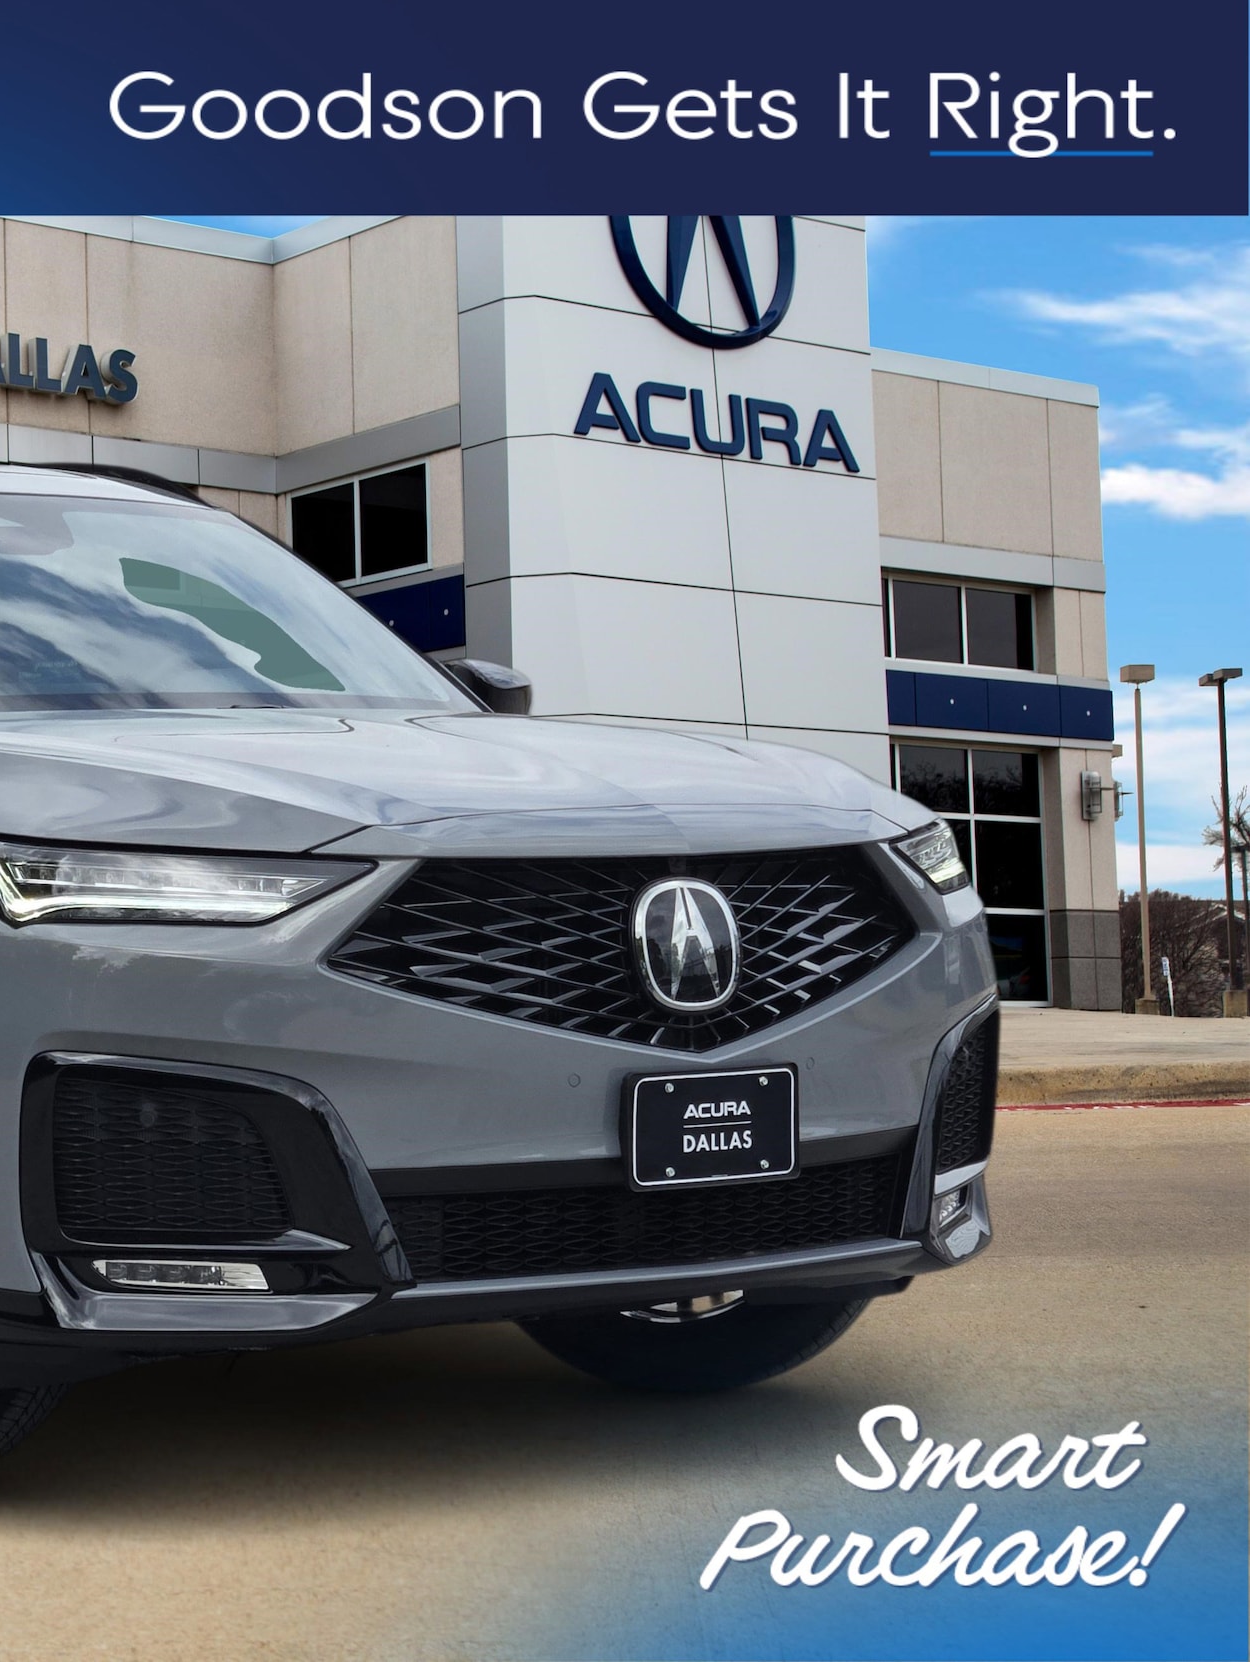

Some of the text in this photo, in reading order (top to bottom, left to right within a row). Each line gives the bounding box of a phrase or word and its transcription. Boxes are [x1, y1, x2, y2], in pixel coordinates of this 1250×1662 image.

[573, 371, 861, 473] ACURA
[683, 1100, 751, 1120] ACURA
[682, 1129, 753, 1154] DALLAS
